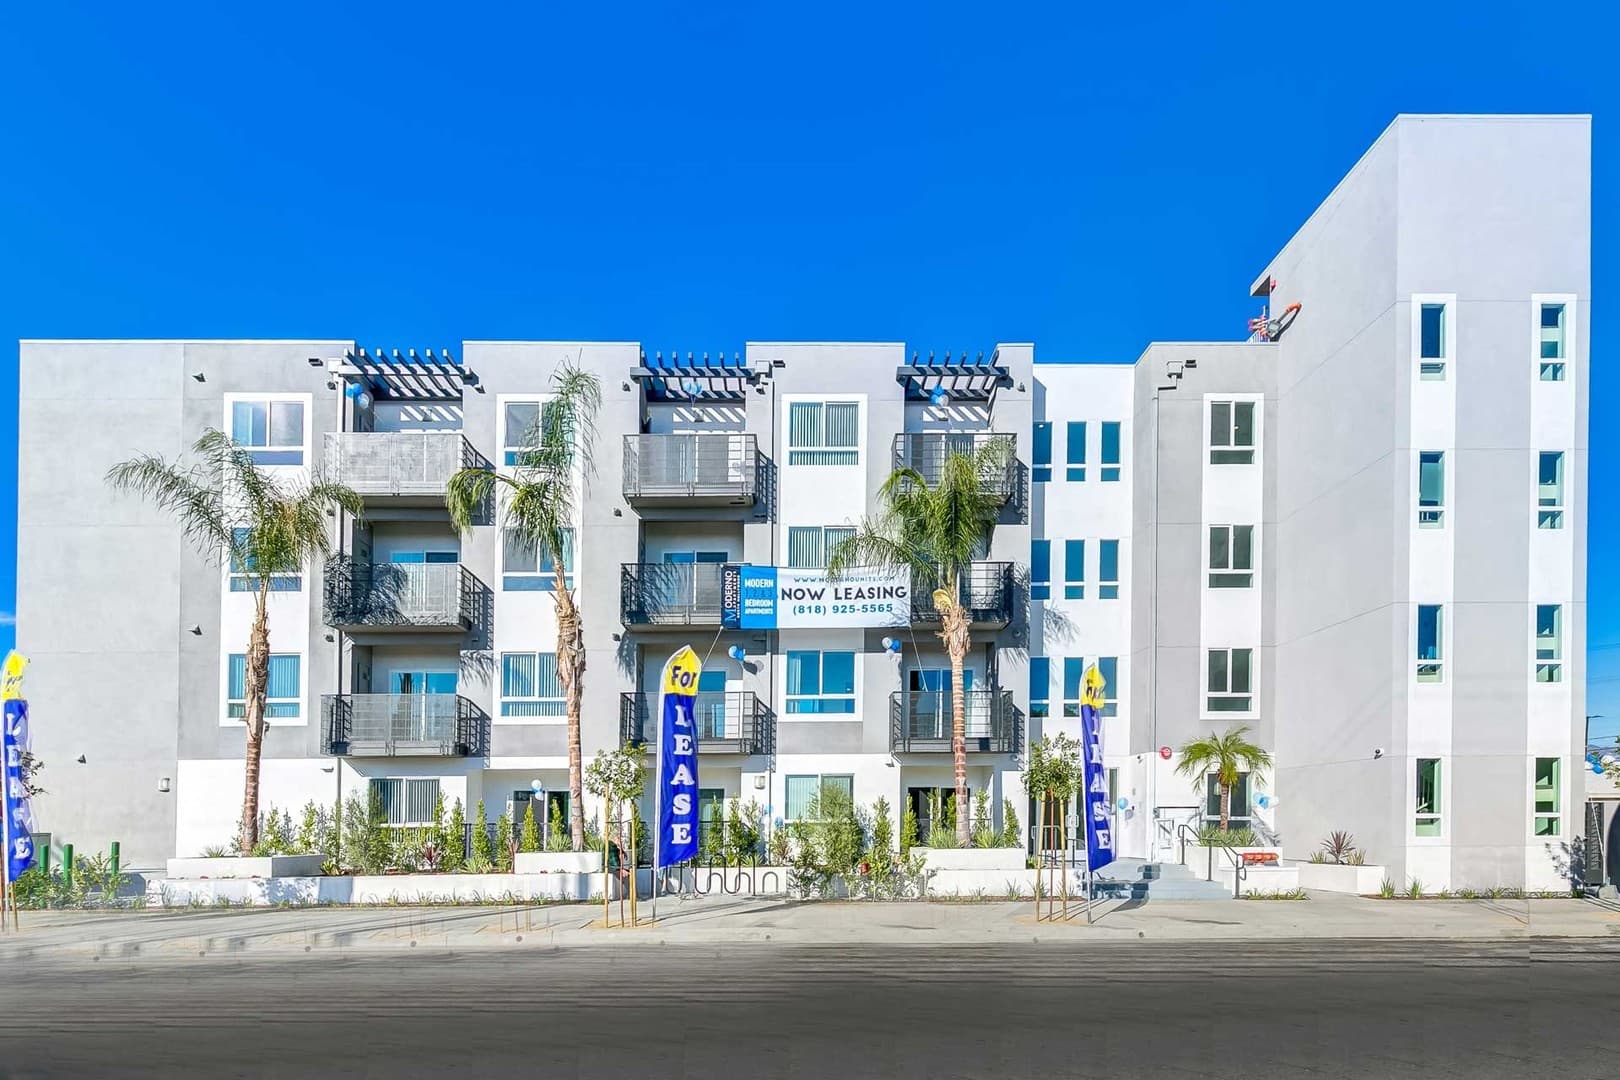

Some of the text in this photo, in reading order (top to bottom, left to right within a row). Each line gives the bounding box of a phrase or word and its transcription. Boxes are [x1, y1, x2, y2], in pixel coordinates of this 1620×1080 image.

[744, 578, 774, 588] MODERN
[724, 570, 737, 622] MODERNO
[781, 586, 907, 601] NOW LEASING
[744, 599, 774, 607] BEDROOM
[793, 603, 893, 616] (818) 925-5565
[670, 704, 695, 845] LEASE
